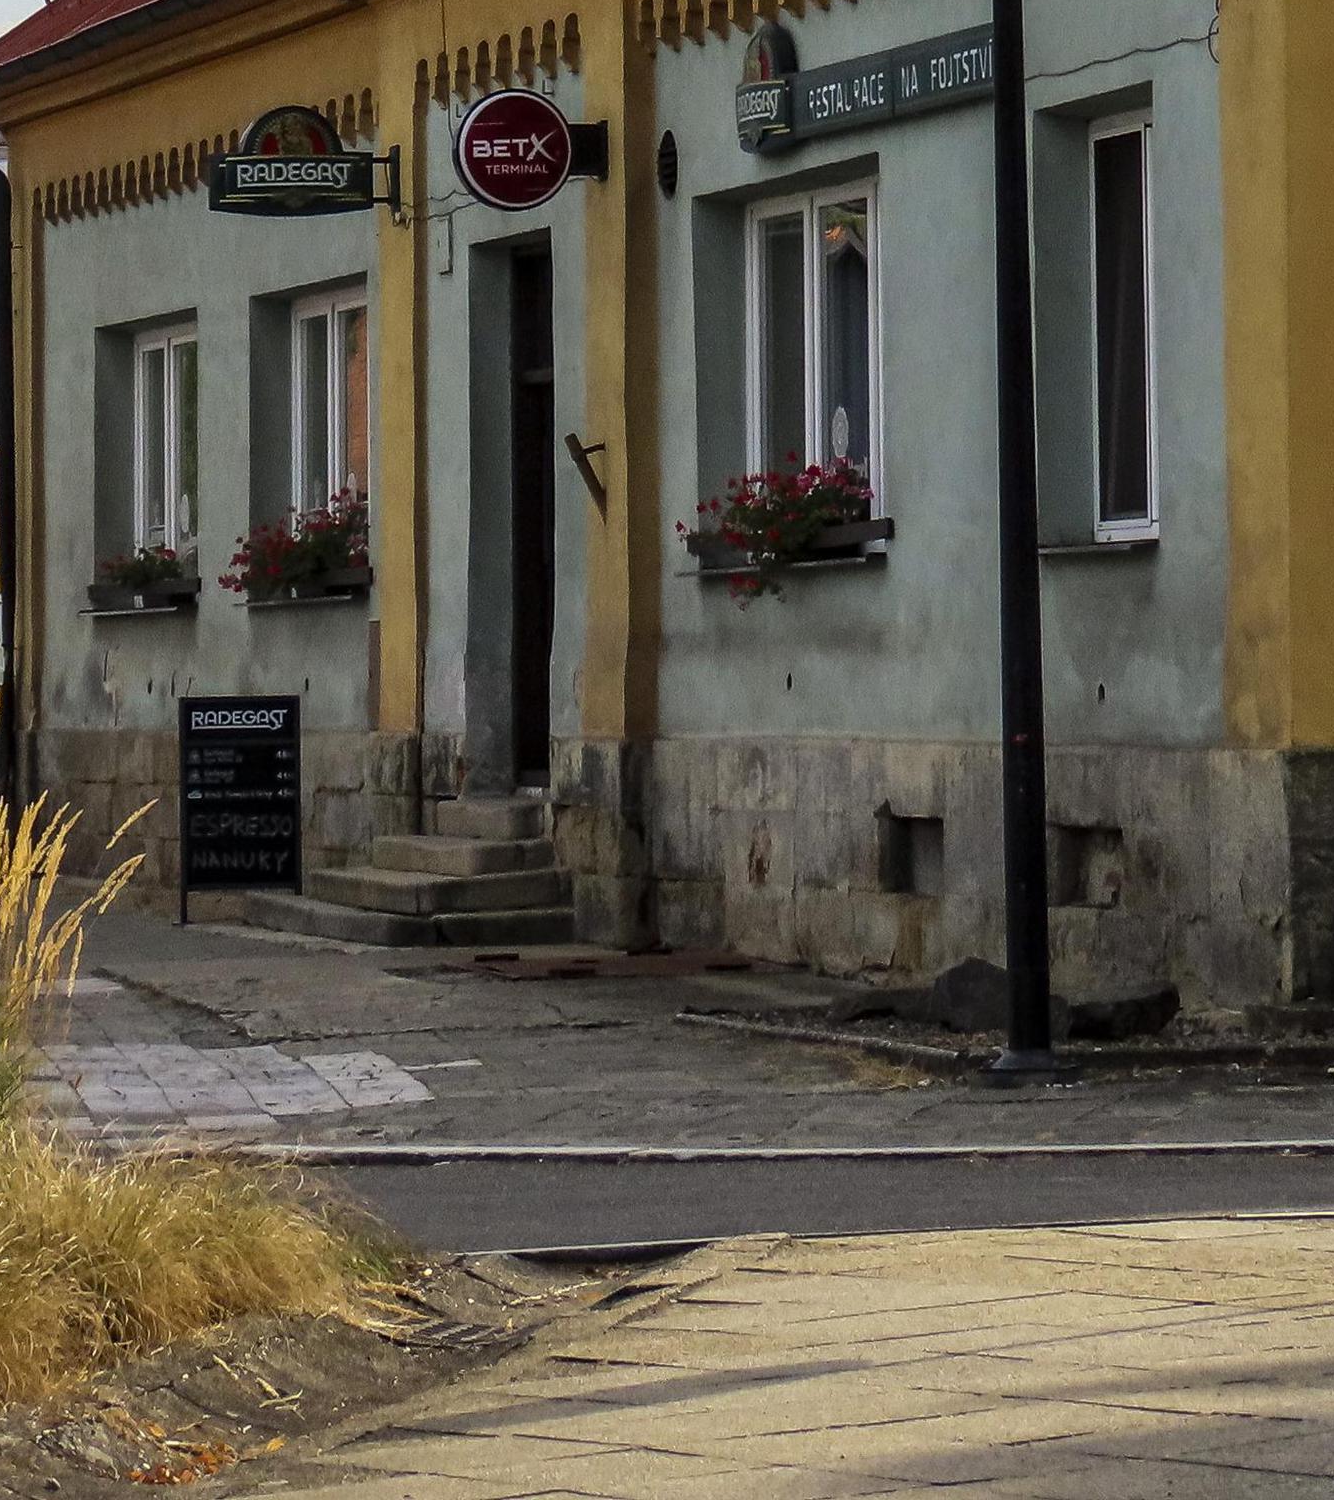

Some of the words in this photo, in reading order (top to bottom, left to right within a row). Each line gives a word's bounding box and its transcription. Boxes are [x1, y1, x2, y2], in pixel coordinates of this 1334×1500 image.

[901, 63, 920, 100] NA
[930, 38, 994, 92] FOJTSTVÍ
[472, 130, 558, 163] BETX
[236, 162, 352, 189] RADEGAST
[485, 164, 549, 175] TERMINAL
[191, 709, 288, 731] RADEGAST
[188, 812, 293, 837] ESPRESSO
[191, 848, 290, 874] NANUKY
